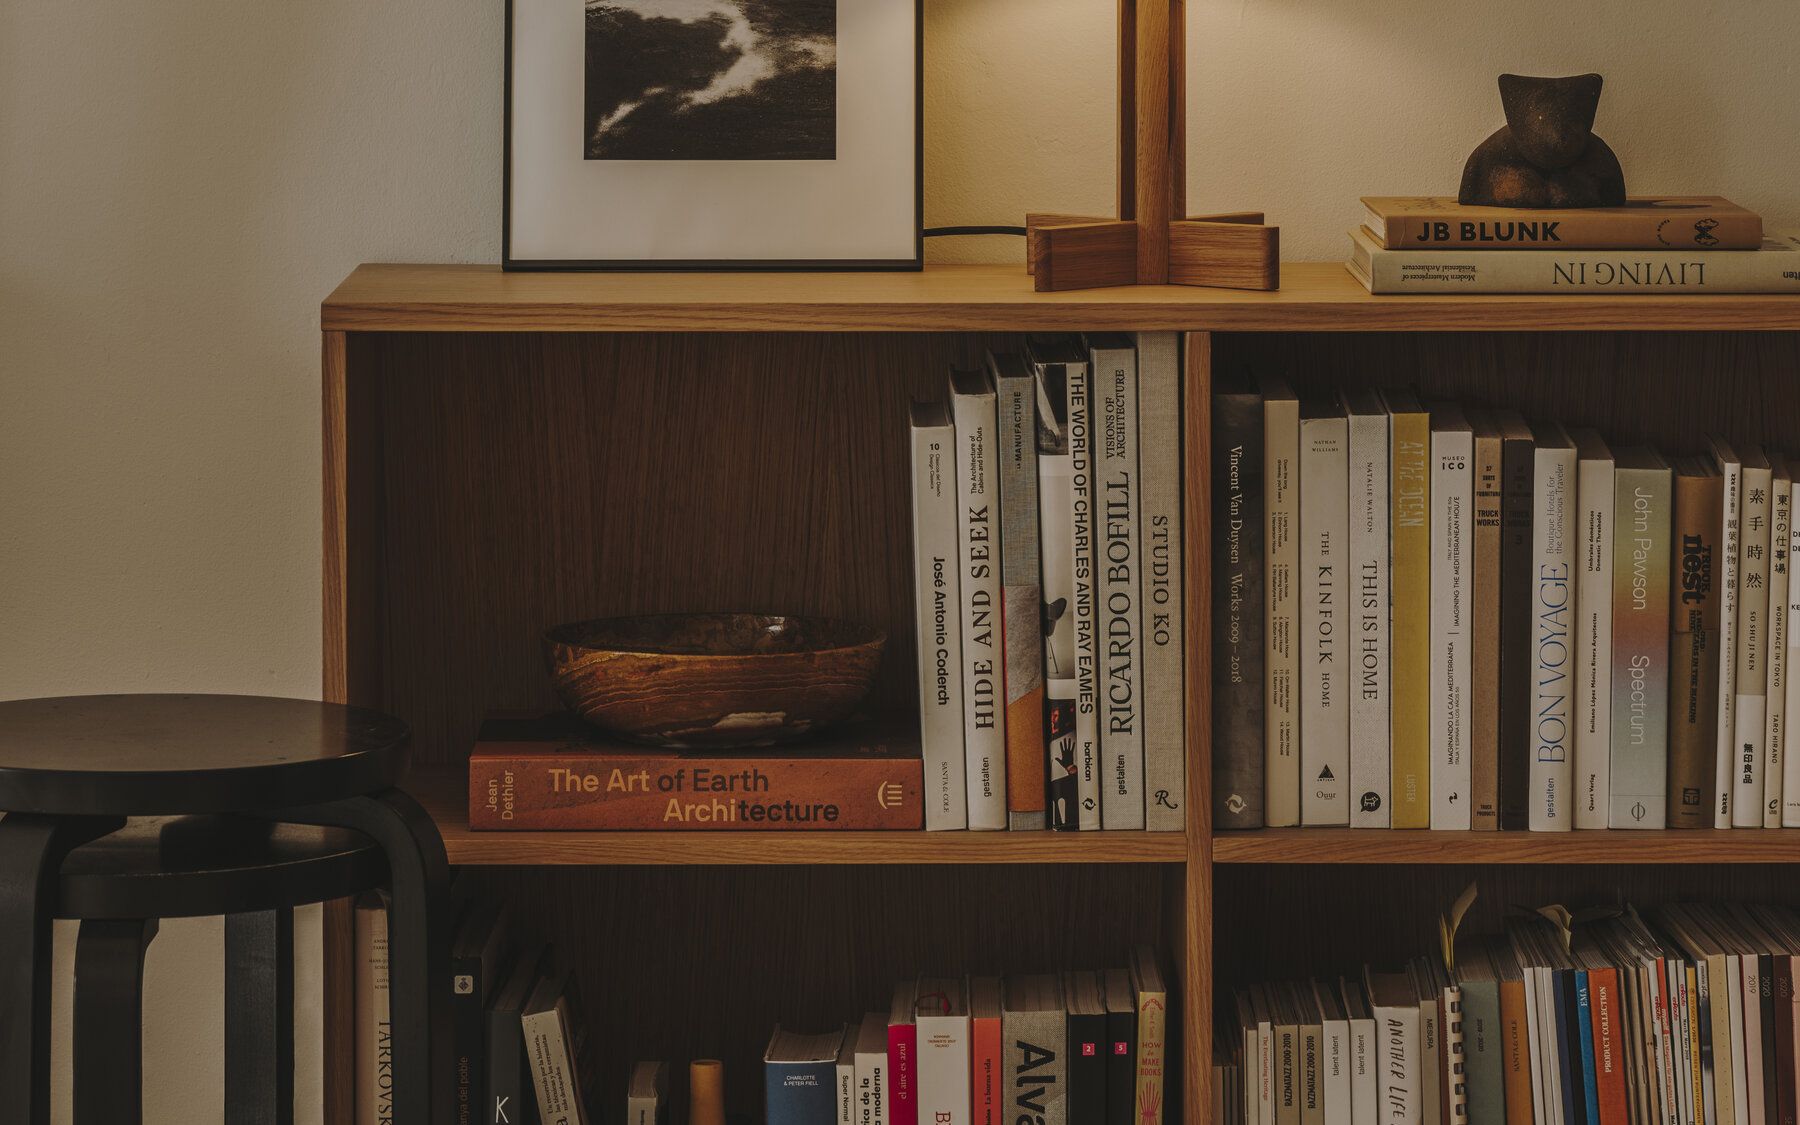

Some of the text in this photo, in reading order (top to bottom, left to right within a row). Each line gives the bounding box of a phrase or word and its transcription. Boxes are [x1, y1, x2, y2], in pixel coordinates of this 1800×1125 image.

[1417, 221, 1561, 242] JB BLUNK
[1554, 262, 1705, 285] LIVING IN
[1014, 392, 1022, 461] MANUFACTURE
[1105, 397, 1115, 460] VISIONS OF
[1114, 369, 1125, 460] ARCHITECTURE
[1399, 441, 1425, 527] AT THE OCEAN
[1546, 490, 1555, 515] Hotels
[1226, 445, 1243, 564] Vincent Van Duysen
[1555, 497, 1563, 539] Conscious
[1070, 372, 1094, 714] THE WORLD OF CHARLES AND RAY EAMES
[1546, 519, 1555, 554] Boutique
[1555, 541, 1563, 554] the
[1632, 486, 1653, 610] John Pawson
[1746, 488, 1764, 588] 素手時然
[1775, 494, 1788, 574] 東京の仕事場
[1151, 515, 1170, 647] STUDIO KO
[1682, 535, 1706, 605] nest
[1701, 545, 1712, 593] TRUCK
[1105, 471, 1134, 735] RICARDO BOFILL
[1230, 573, 1243, 611] Works
[933, 557, 949, 705] José Antonio Coderch
[969, 506, 994, 730] HIDE AND SEEK
[1229, 615, 1241, 643] 2009
[1318, 532, 1333, 708] THE KINFOLK HOME
[1362, 560, 1378, 700] THIS IS HOME
[1750, 611, 1756, 622] SO
[1538, 563, 1568, 764] BON VOYAGE
[1749, 643, 1756, 651] JI
[1231, 655, 1243, 683] 2018
[1589, 689, 1597, 706] López
[1627, 655, 1649, 744] Spectrum
[548, 769, 769, 792] The Art of Earth
[980, 757, 991, 797] gestalten
[1083, 741, 1093, 781] barbican
[1116, 754, 1125, 796] gestalten
[1743, 743, 1753, 784] 無印良品
[486, 779, 497, 812] Jean
[502, 770, 514, 820] Dethier
[1406, 774, 1416, 802] LUSTER
[1546, 777, 1555, 819] gestalten
[663, 798, 839, 821] Architecture
[1579, 988, 1588, 1007] EMA
[1748, 975, 1756, 994] 2019
[1762, 976, 1770, 997] 2020
[1779, 977, 1788, 997] 2020
[1426, 1019, 1434, 1049] MESURA
[1599, 986, 1611, 1073] PRODUCT COLLECTION
[897, 1043, 906, 1060] azul
[900, 1062, 906, 1071] es
[1142, 1058, 1159, 1066] MAKE
[1283, 1034, 1292, 1106] RAZZMATAZZ 2000-2010
[1387, 1019, 1408, 1118] ANOTHER LIFE
[860, 1078, 869, 1105] de la
[872, 1068, 881, 1116] moderna
[898, 1074, 907, 1089] aire
[1141, 1068, 1161, 1076] BOOKS
[1306, 1036, 1316, 1109] RAZZMATAZZ 2000-2010
[495, 1096, 509, 1124] K
